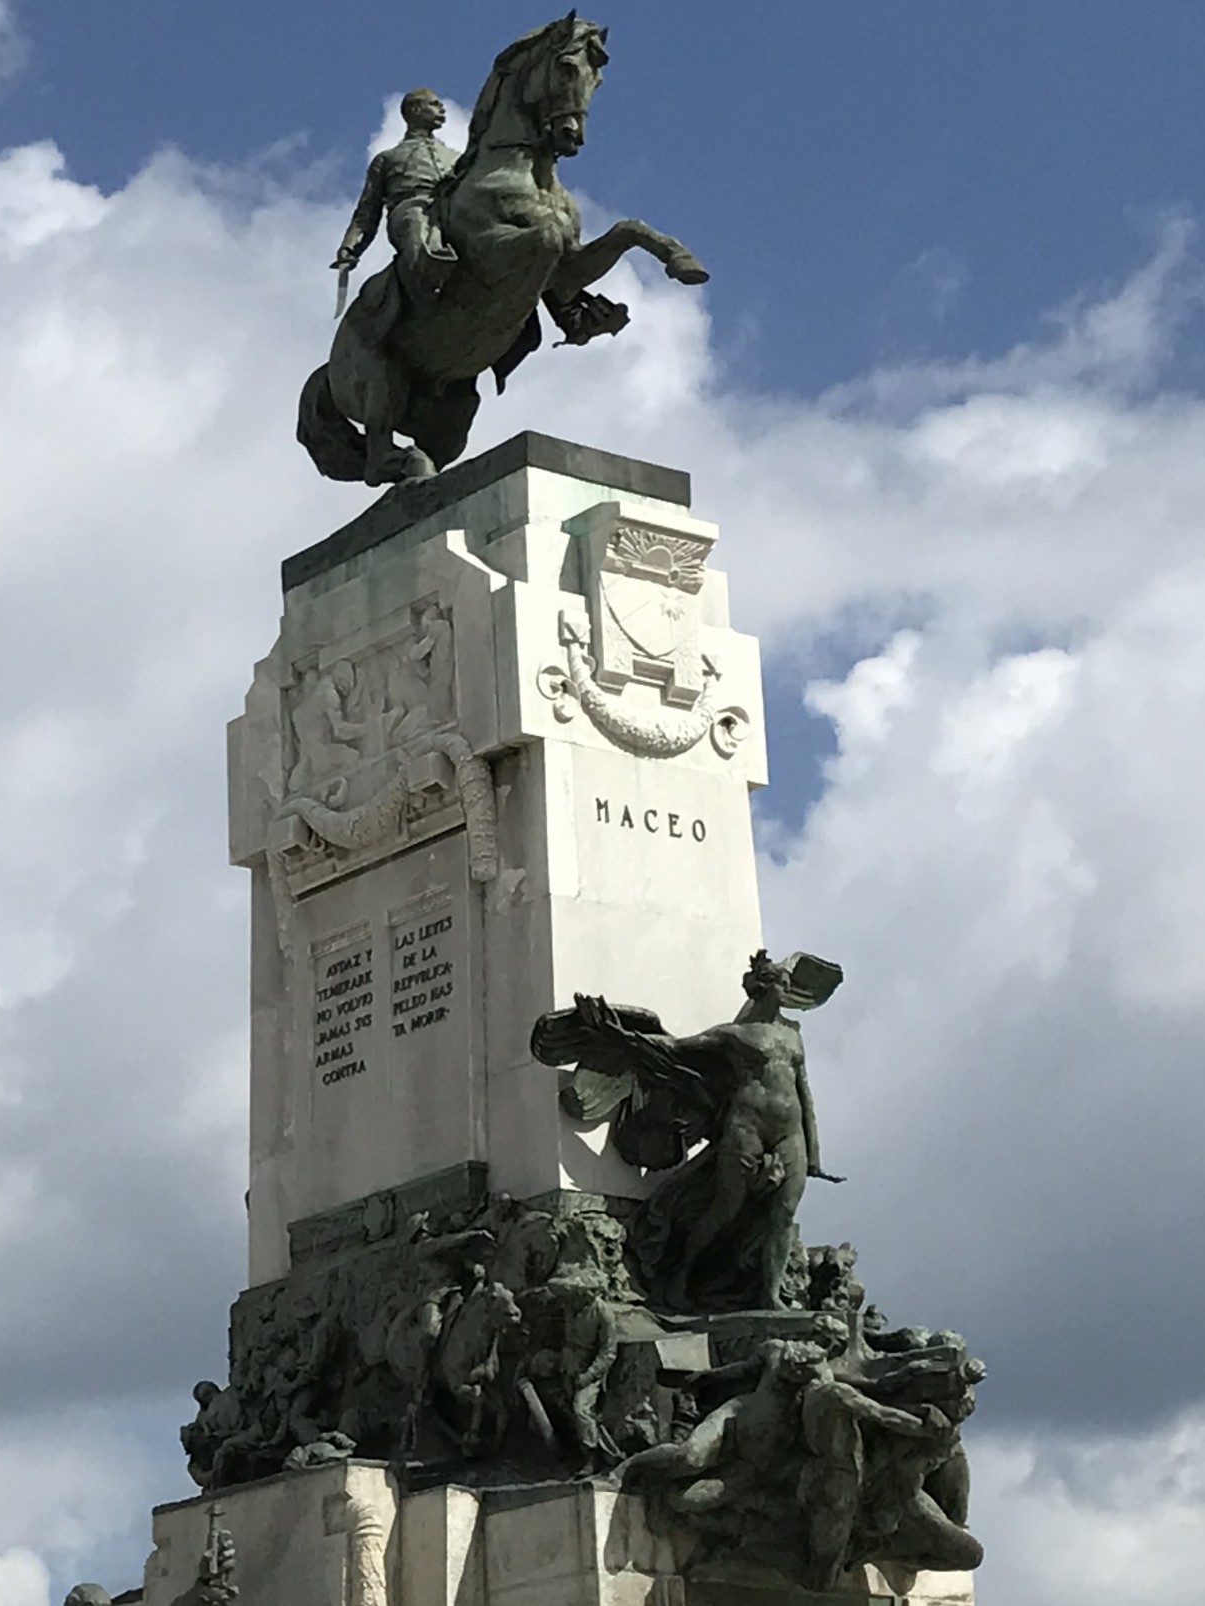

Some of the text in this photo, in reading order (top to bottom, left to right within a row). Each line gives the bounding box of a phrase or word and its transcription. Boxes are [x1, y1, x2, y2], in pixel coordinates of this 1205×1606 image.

[595, 797, 706, 842] MACEO
[395, 916, 453, 951] LAS LEYES
[366, 949, 373, 963] Y
[403, 946, 437, 969] DE LA
[393, 982, 453, 1016] PELEO HAS
[316, 1008, 332, 1025] NO
[392, 1021, 406, 1037] TA
[316, 1021, 351, 1046] JAMAS
[315, 1042, 354, 1068] ARMAS
[322, 1060, 366, 1086] CONTRA
